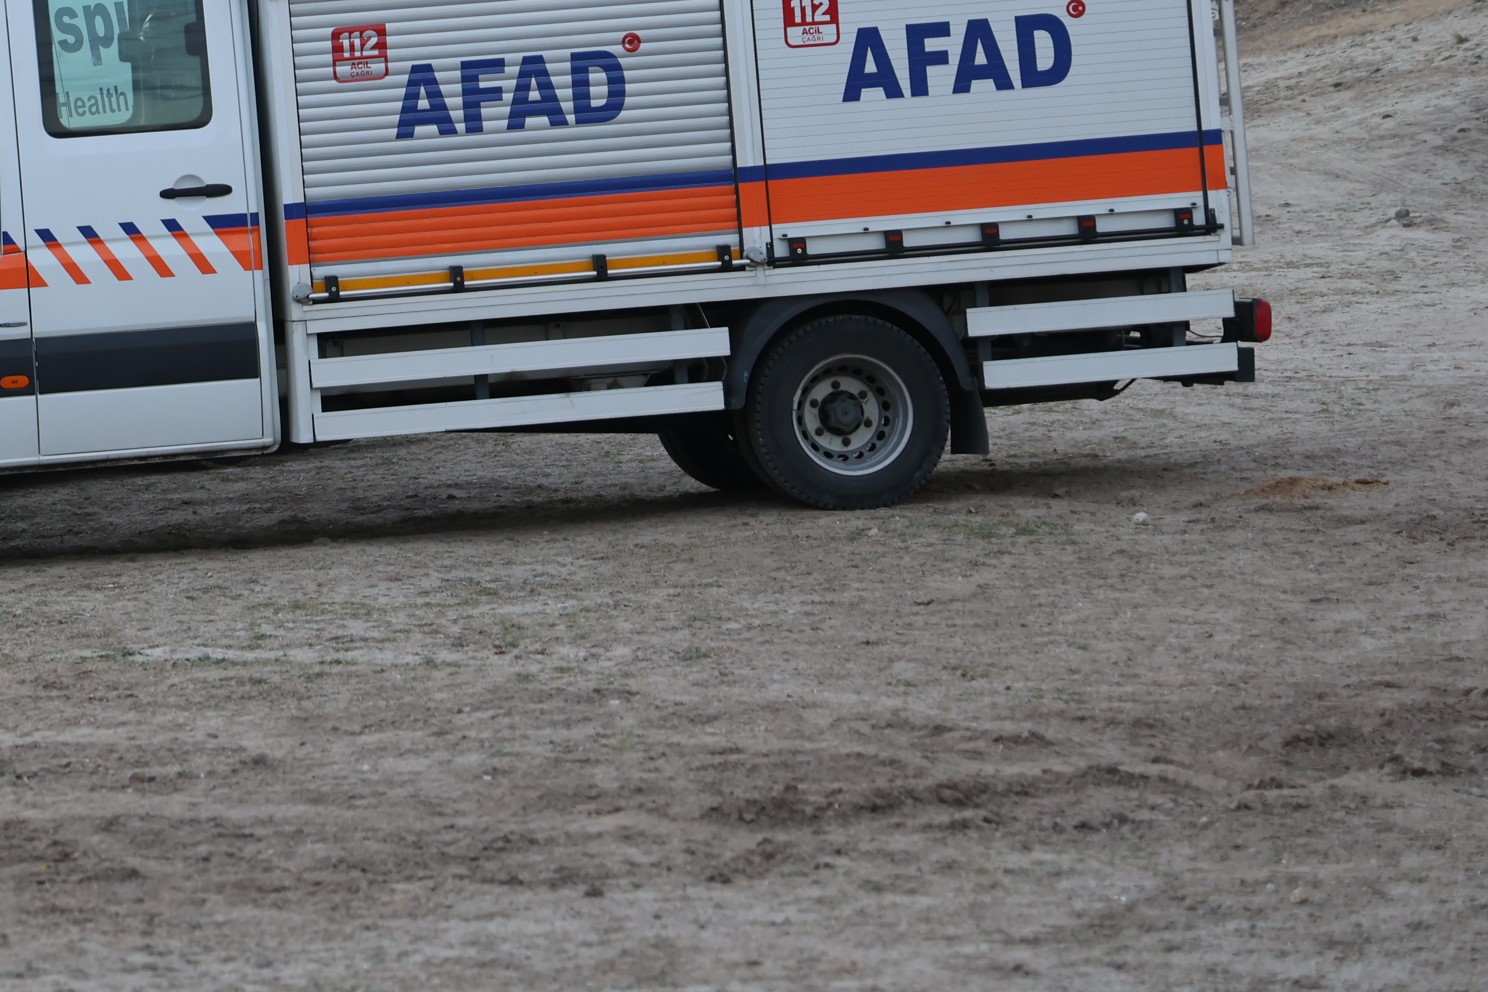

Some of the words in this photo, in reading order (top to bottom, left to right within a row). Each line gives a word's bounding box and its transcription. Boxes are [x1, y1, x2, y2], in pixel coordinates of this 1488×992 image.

[339, 29, 379, 58] 112
[842, 13, 1073, 102] AFAD
[395, 50, 626, 139] AFAD
